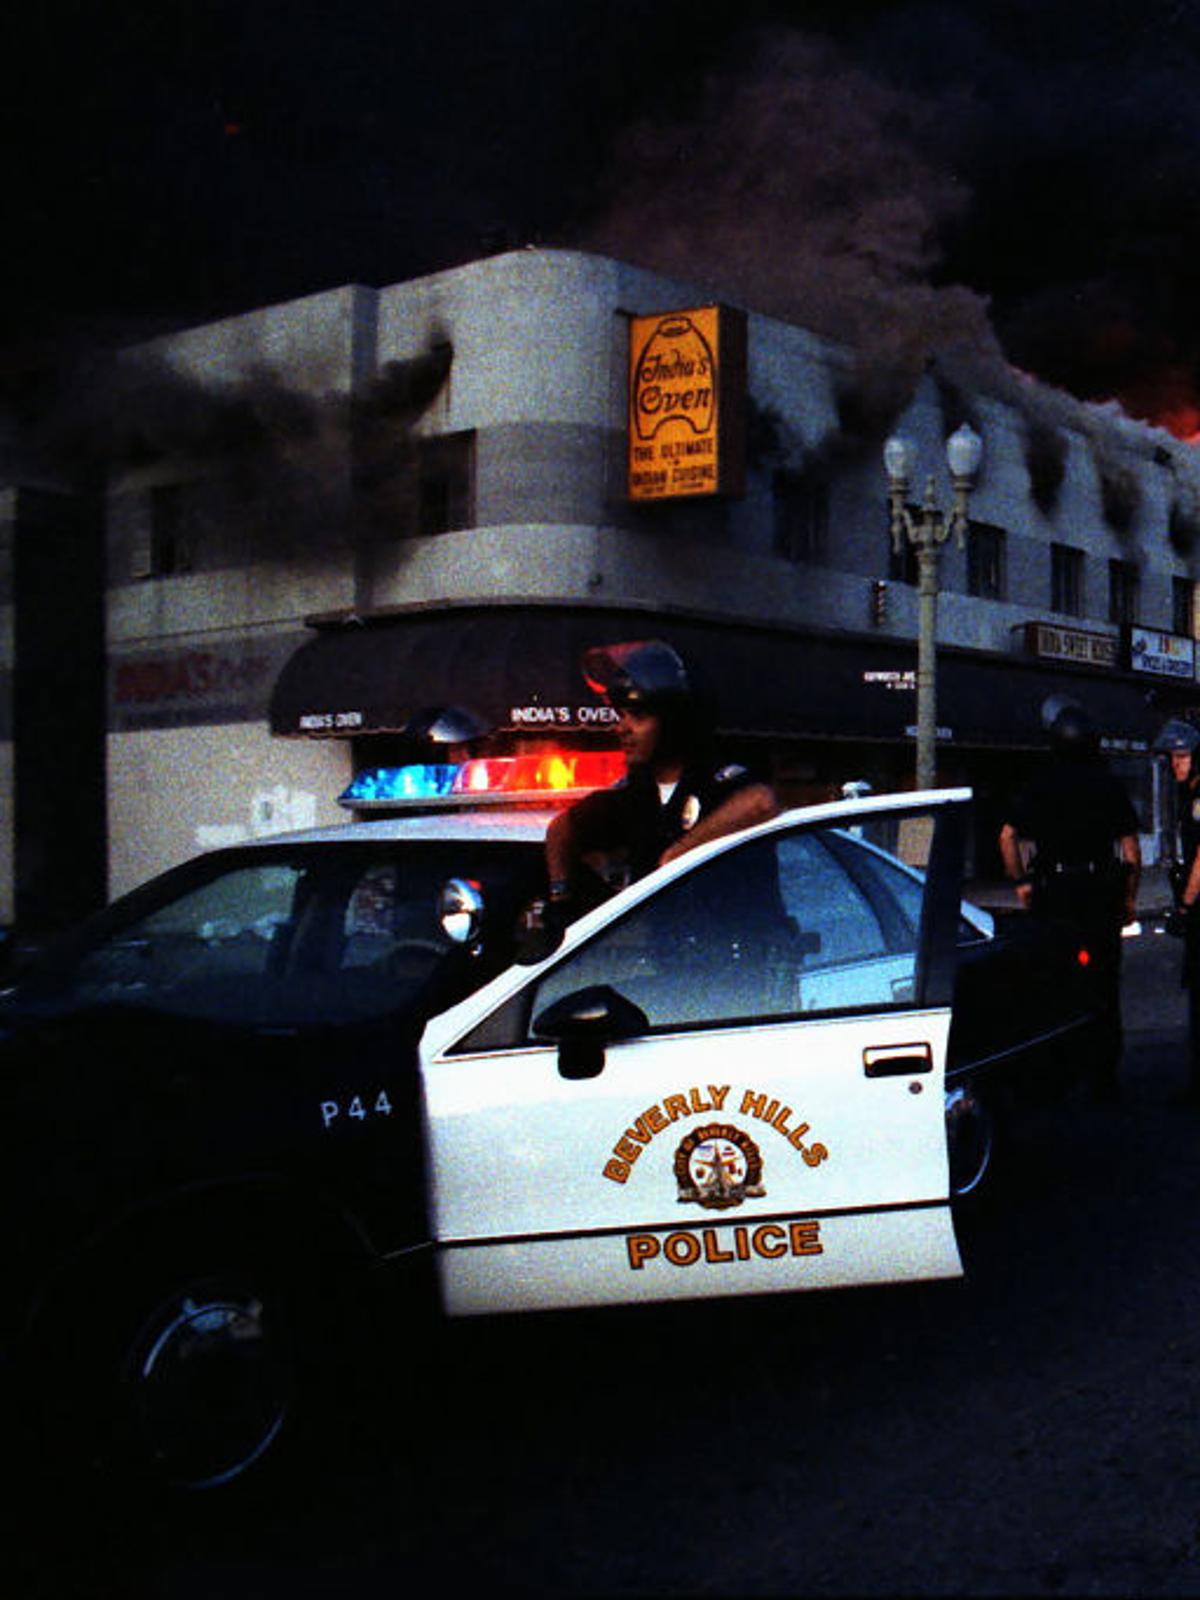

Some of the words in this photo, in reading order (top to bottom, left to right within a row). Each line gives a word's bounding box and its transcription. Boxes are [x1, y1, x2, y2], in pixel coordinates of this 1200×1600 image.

[640, 386, 711, 414] Oven
[633, 445, 654, 464] THE
[661, 438, 713, 459] ULTIMATE
[510, 704, 571, 722] INDIA'S
[602, 1085, 731, 1184] BEVERLY
[739, 1089, 829, 1168] HILLS
[626, 1220, 824, 1270] POLICE
